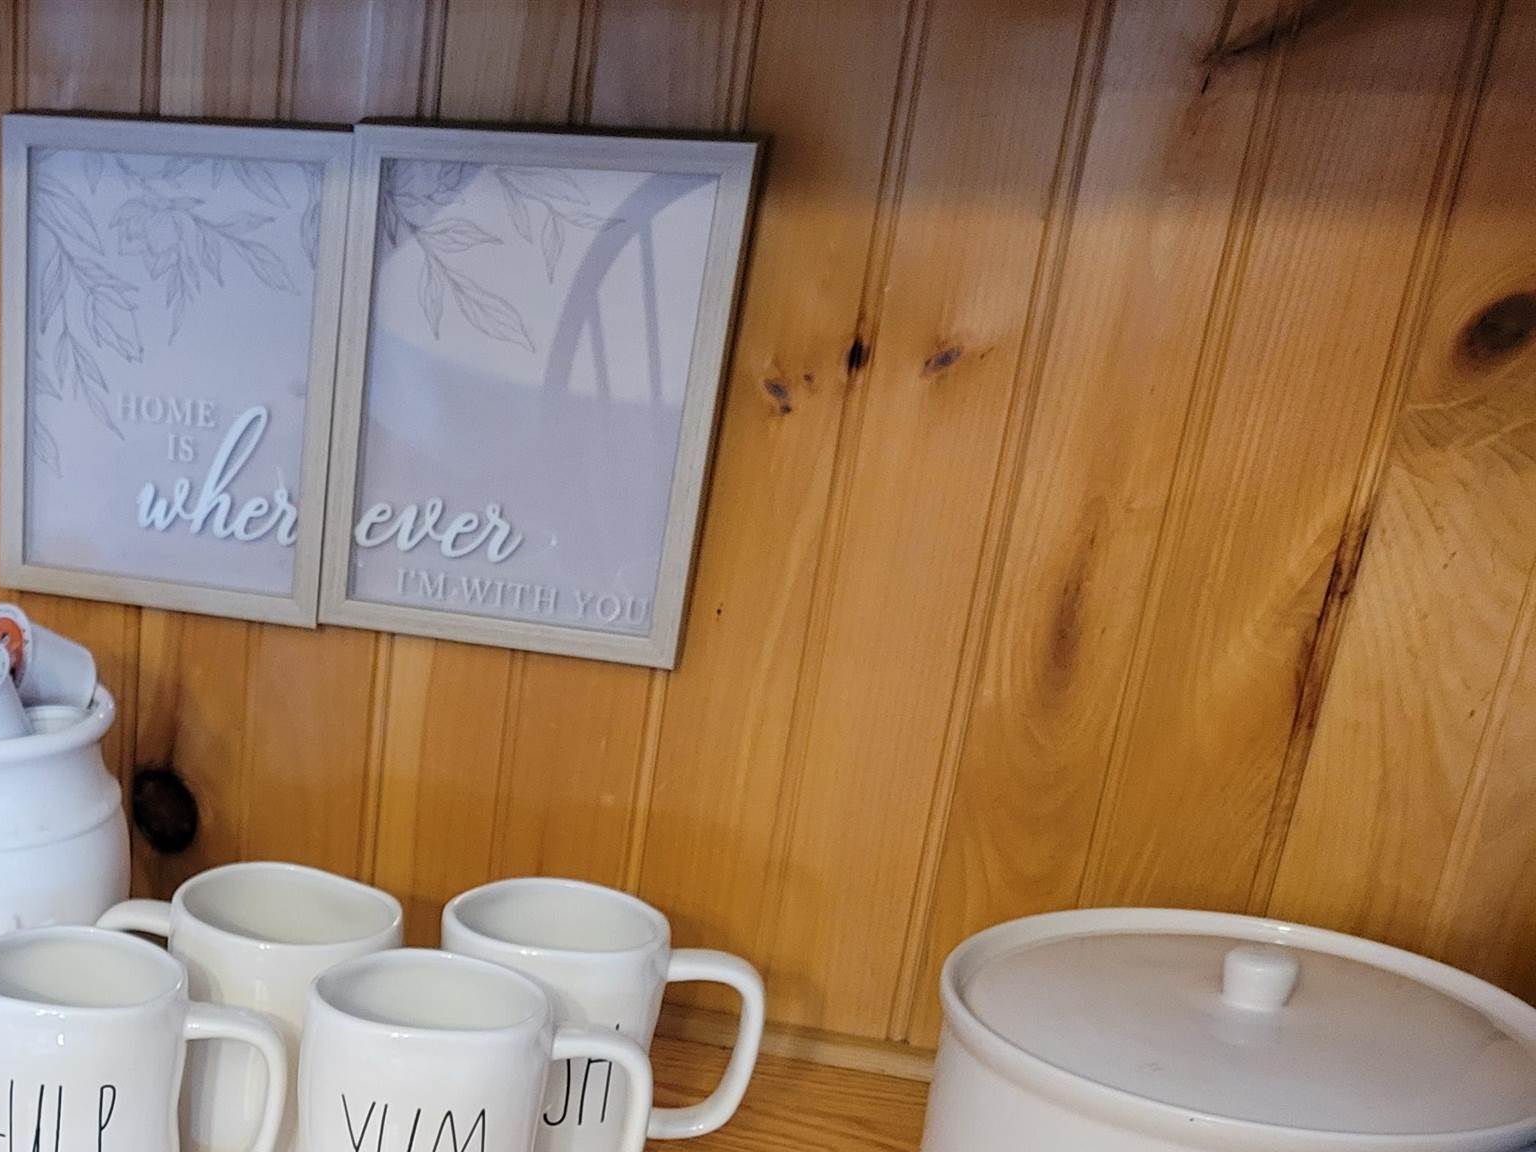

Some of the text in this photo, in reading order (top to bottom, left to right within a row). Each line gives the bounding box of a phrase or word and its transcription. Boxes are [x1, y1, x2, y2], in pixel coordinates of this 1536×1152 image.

[117, 392, 215, 428] HOME
[166, 432, 195, 463] IS
[354, 497, 525, 563] ever
[396, 567, 650, 624] I'M WITH YOU
